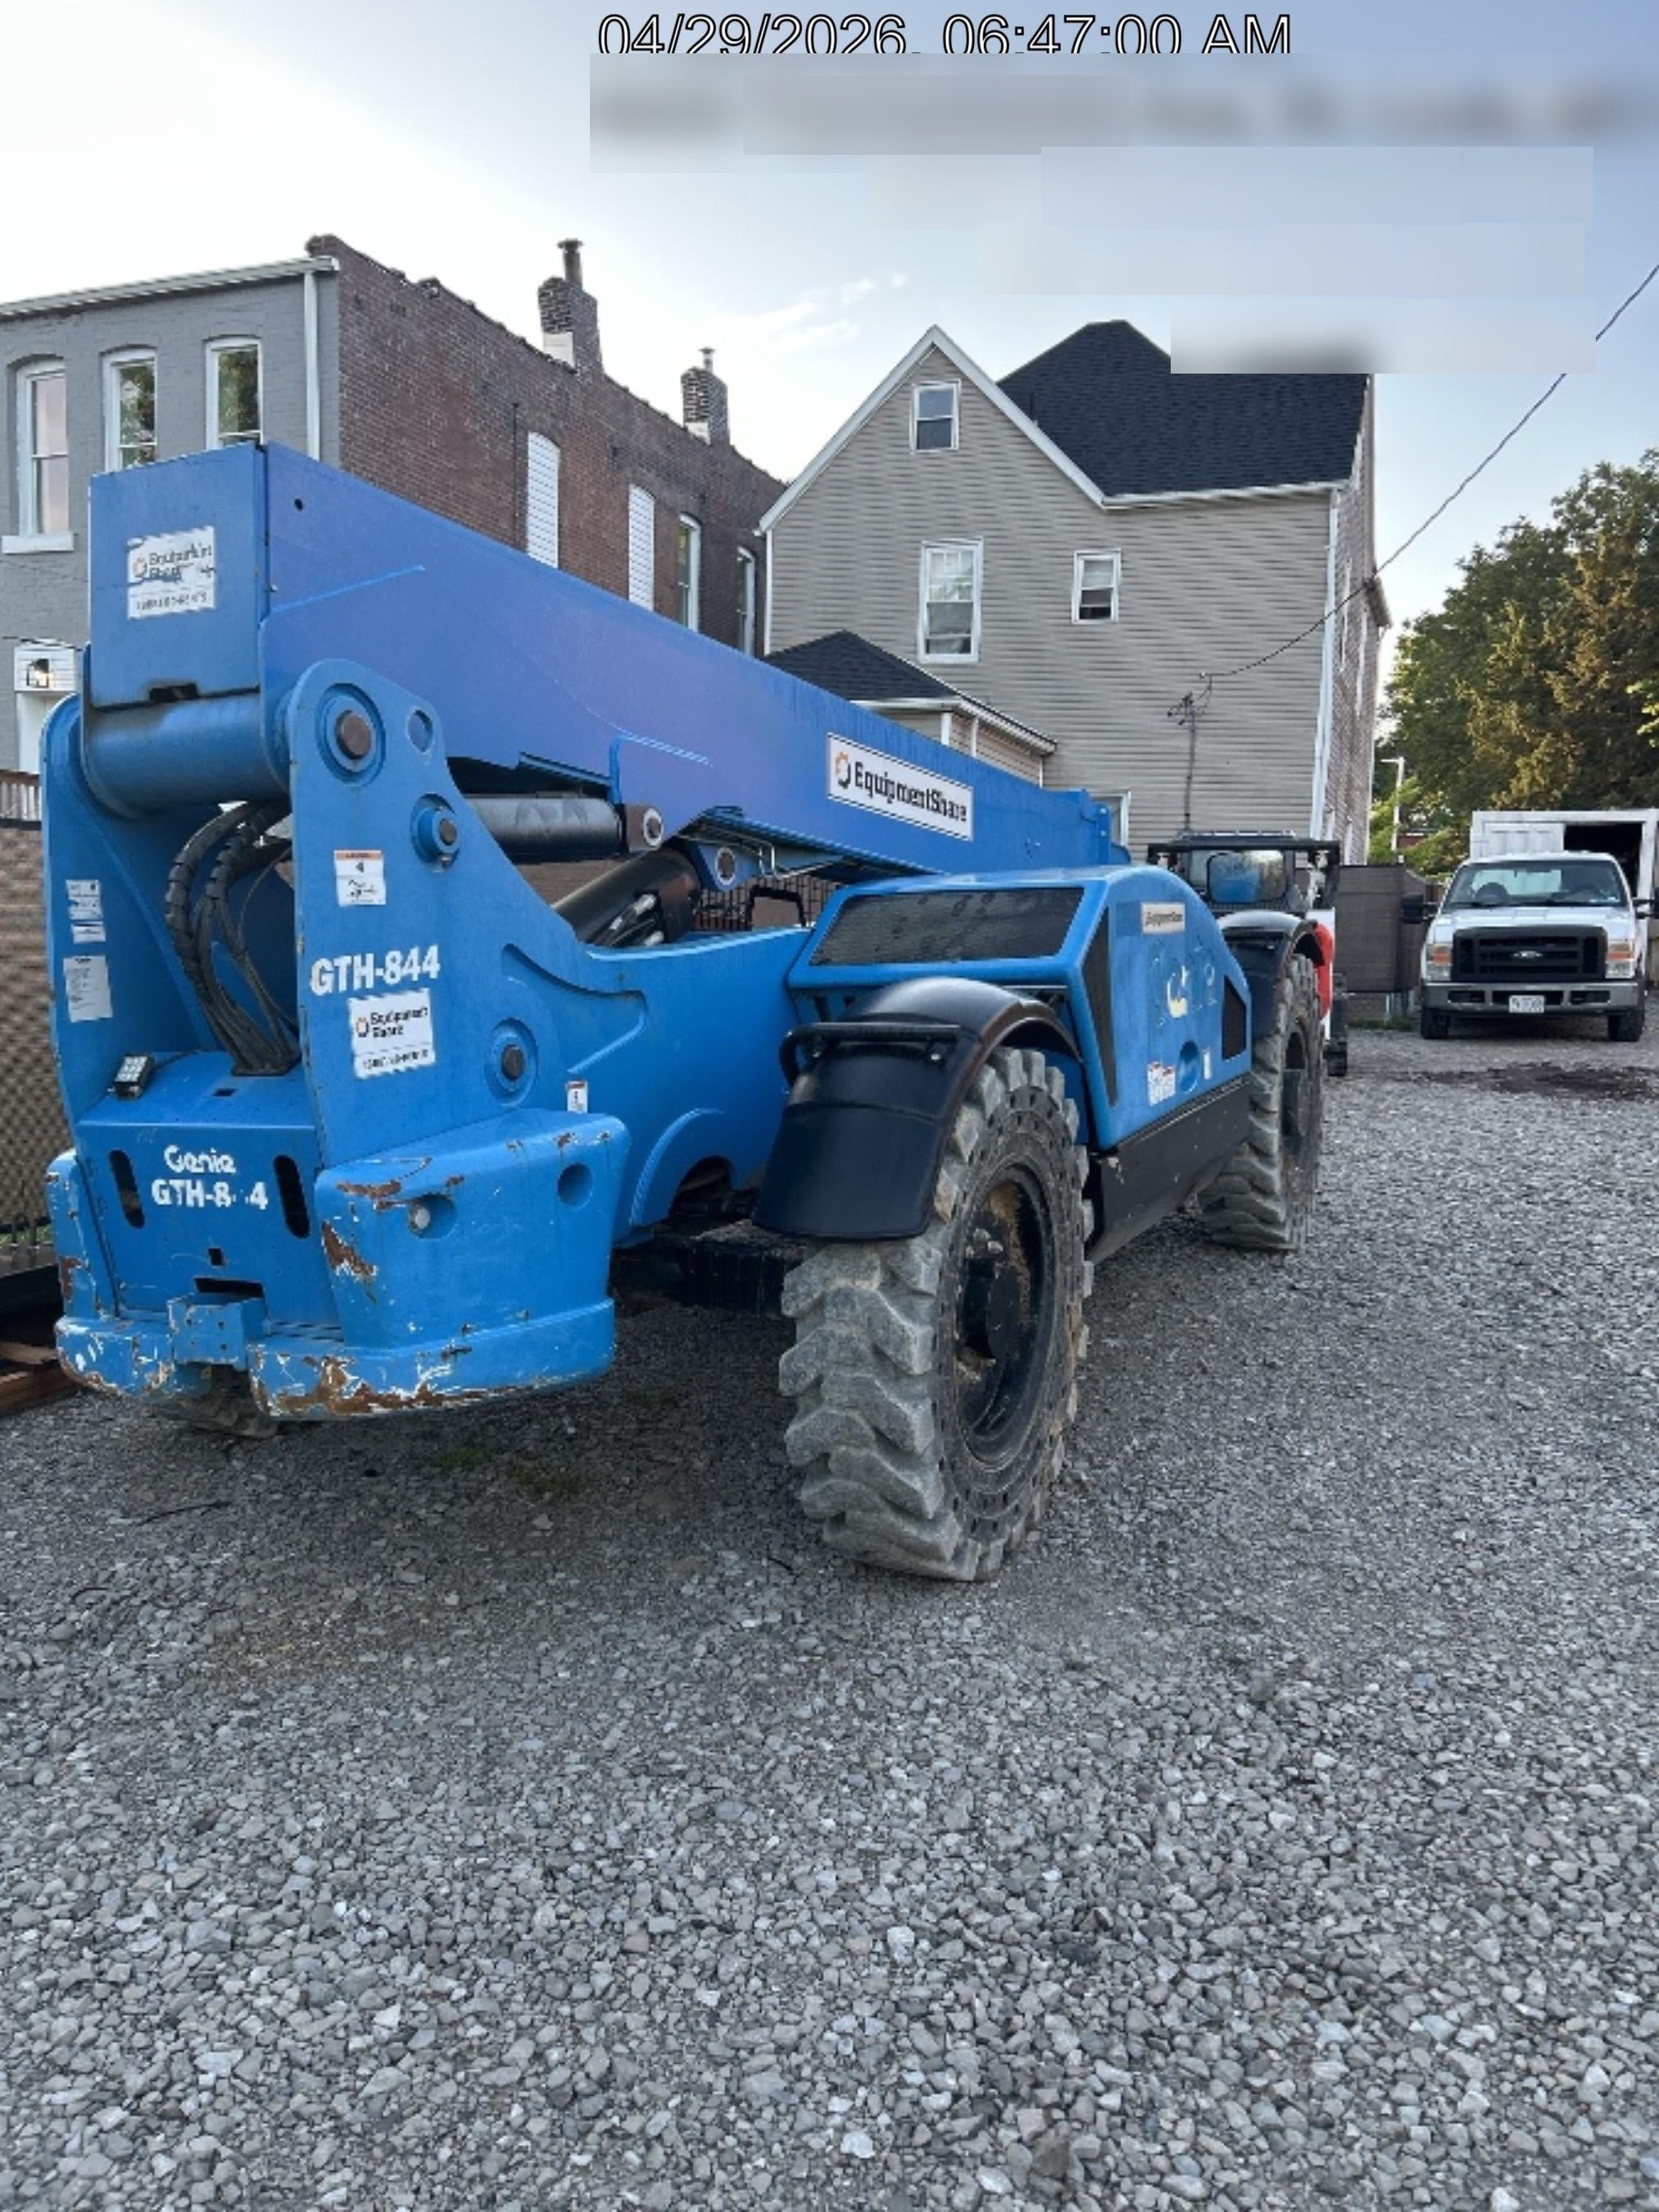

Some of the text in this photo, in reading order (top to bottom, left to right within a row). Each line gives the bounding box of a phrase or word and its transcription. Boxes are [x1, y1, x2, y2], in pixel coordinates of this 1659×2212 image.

[854, 761, 967, 822] EquipmentShare
[310, 944, 441, 996] GTH-844
[164, 1145, 237, 1173] Genie
[151, 1179, 269, 1210] GTH-84
